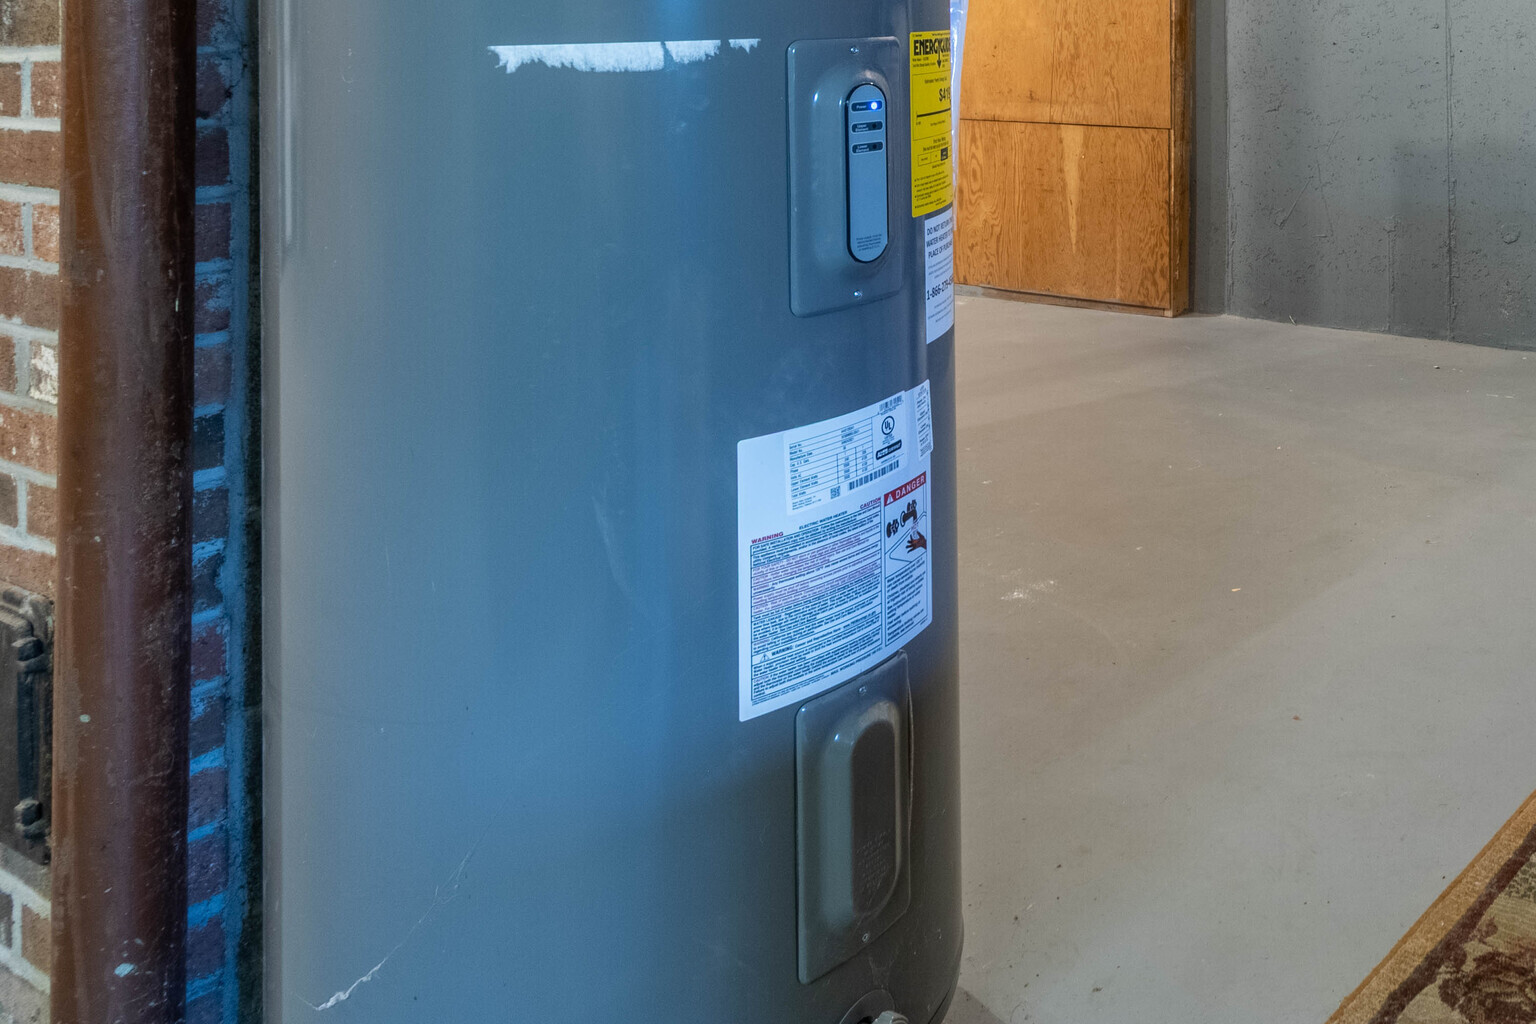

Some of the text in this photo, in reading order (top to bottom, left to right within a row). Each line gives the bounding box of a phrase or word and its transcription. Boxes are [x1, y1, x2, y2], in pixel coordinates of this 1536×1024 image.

[895, 475, 926, 499] DANGER
[859, 496, 882, 510] CAUTION
[751, 531, 784, 545] WARNING
